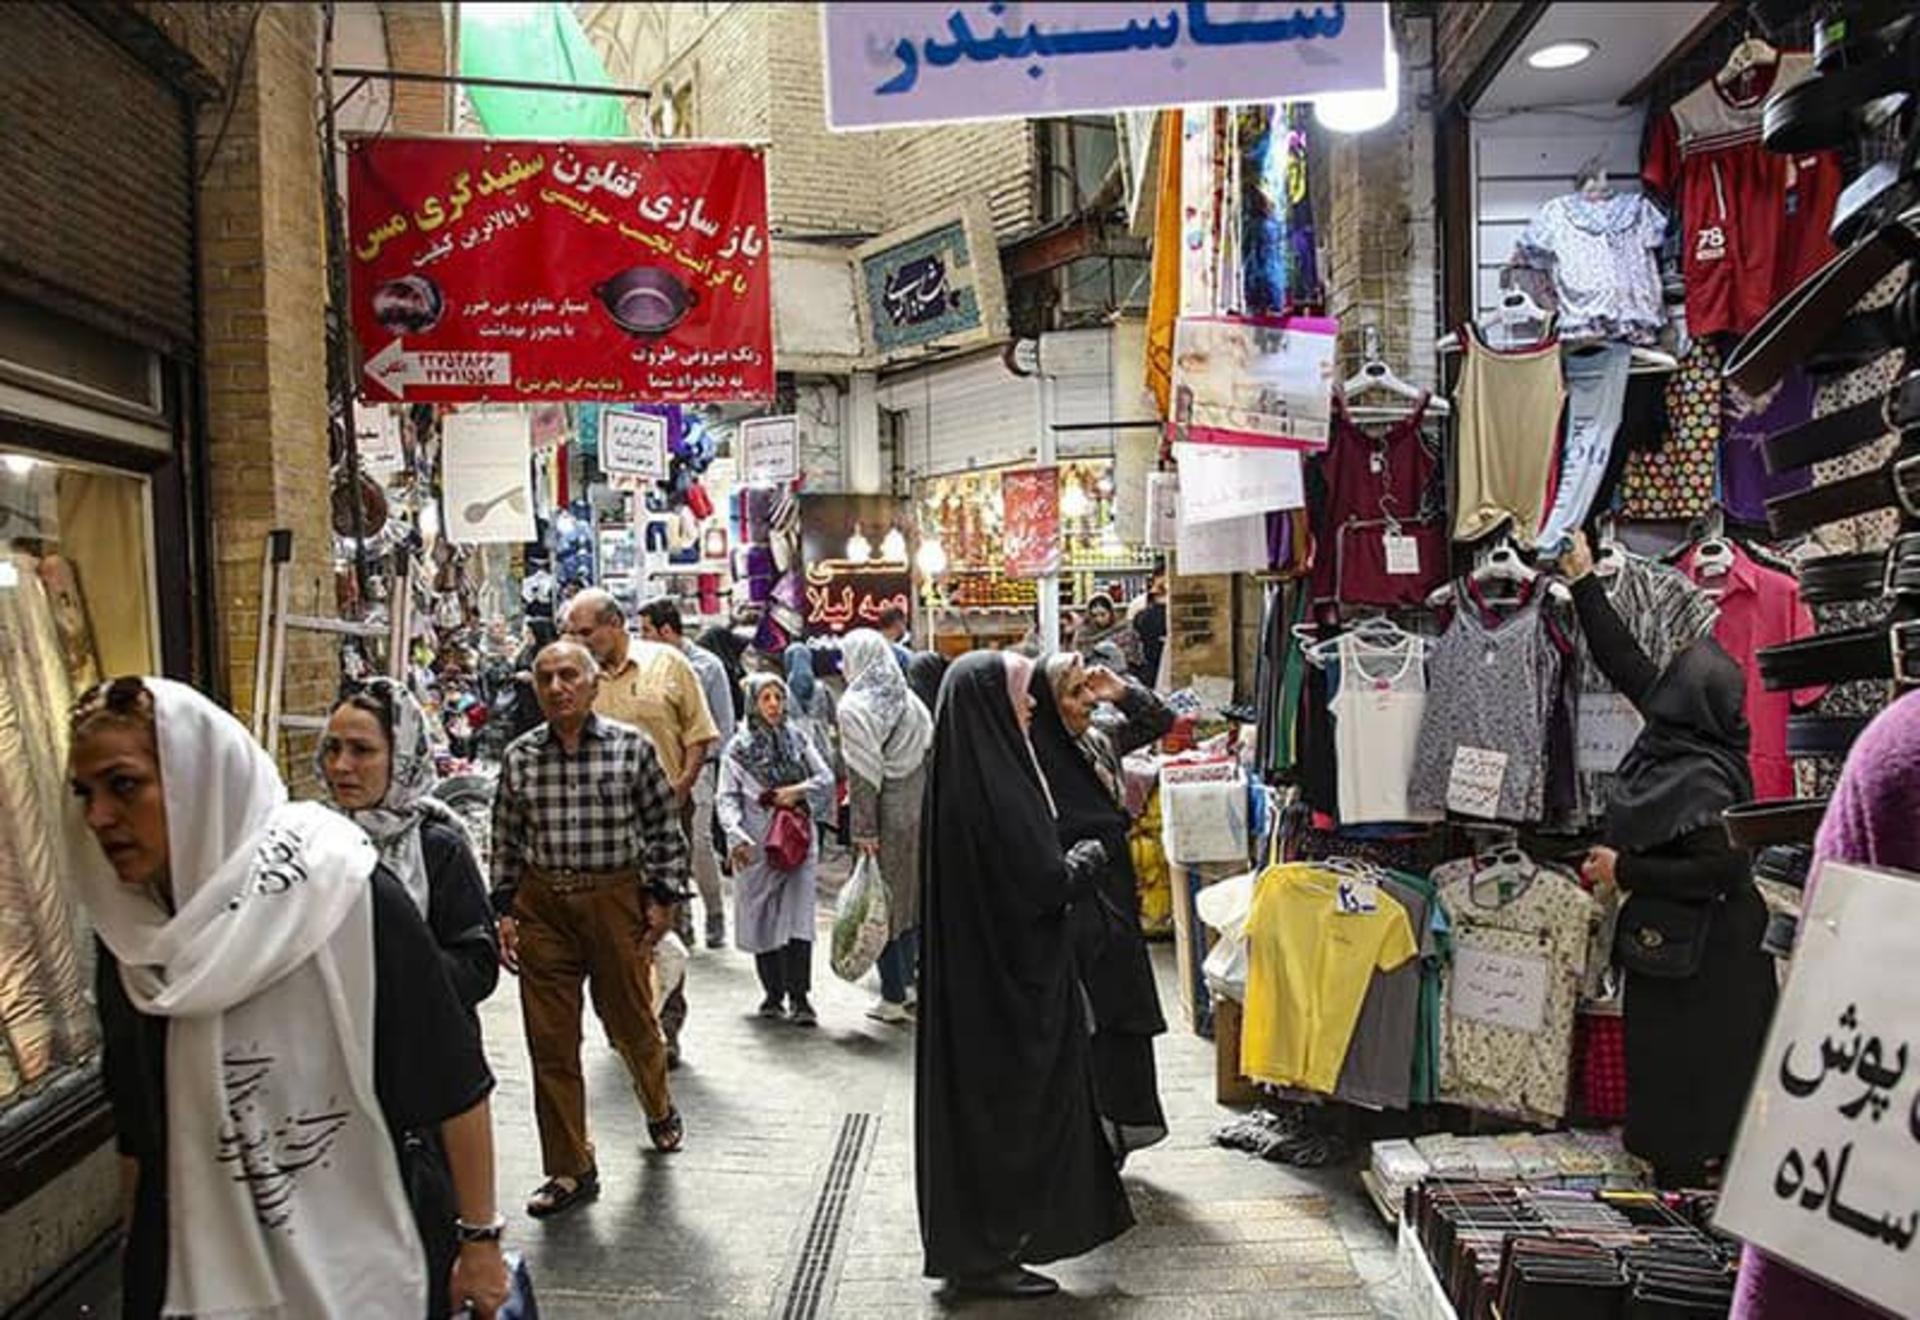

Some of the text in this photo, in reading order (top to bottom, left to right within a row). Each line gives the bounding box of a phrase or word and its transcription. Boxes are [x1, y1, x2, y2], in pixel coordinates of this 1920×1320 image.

[552, 146, 642, 200] تفلون
[355, 213, 408, 262] مس
[1780, 1003, 1908, 1123] پوش
[1774, 1140, 1919, 1253] ساده
